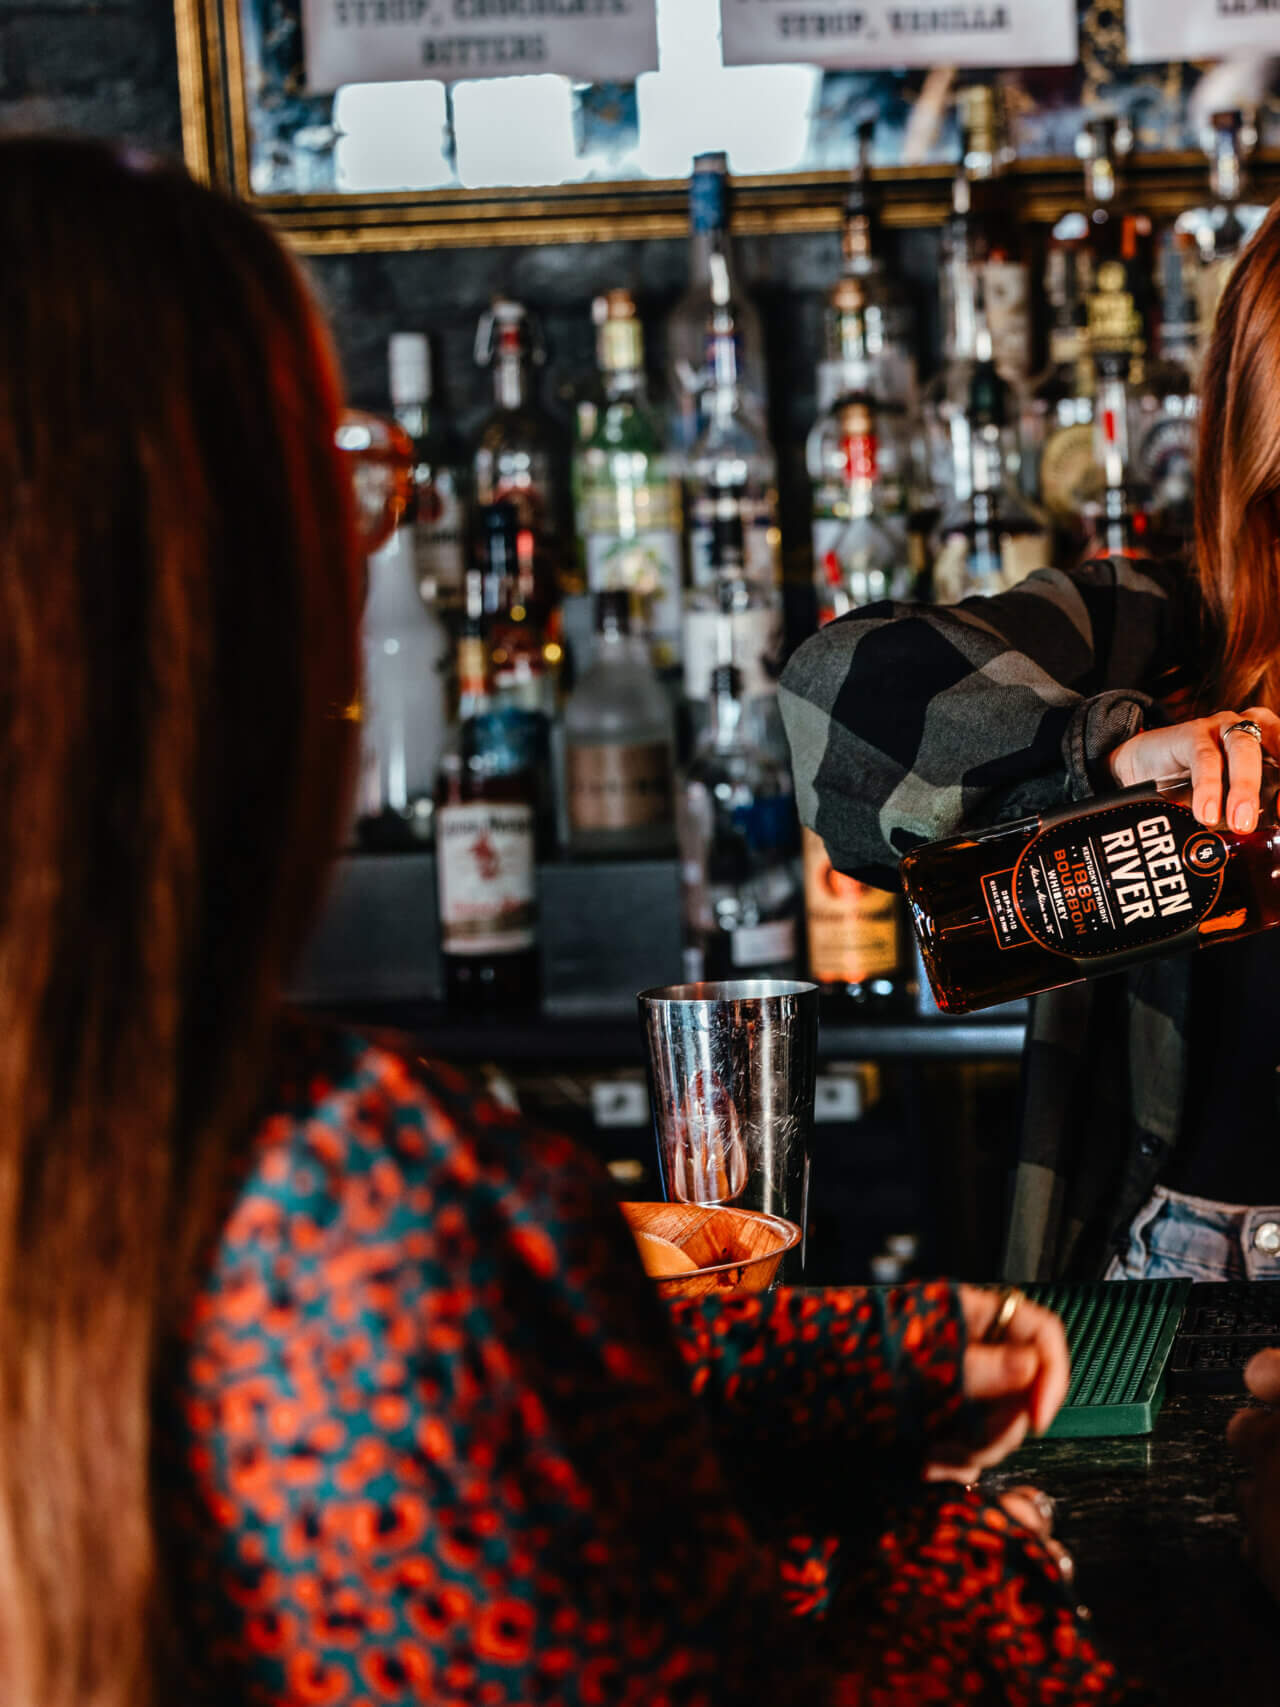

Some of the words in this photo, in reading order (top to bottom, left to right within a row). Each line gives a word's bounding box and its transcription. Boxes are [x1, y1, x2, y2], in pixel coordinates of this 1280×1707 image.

[421, 33, 547, 67] BITTERS
[1047, 869, 1069, 920] WHISKEY
[1054, 849, 1087, 935] BOURBON
[1071, 862, 1097, 914] 1885
[1082, 846, 1098, 885] KENTUCKY
[1093, 886, 1109, 923] STRAIGHT
[1101, 828, 1155, 925] RIVER
[1137, 815, 1193, 917] GREEN
